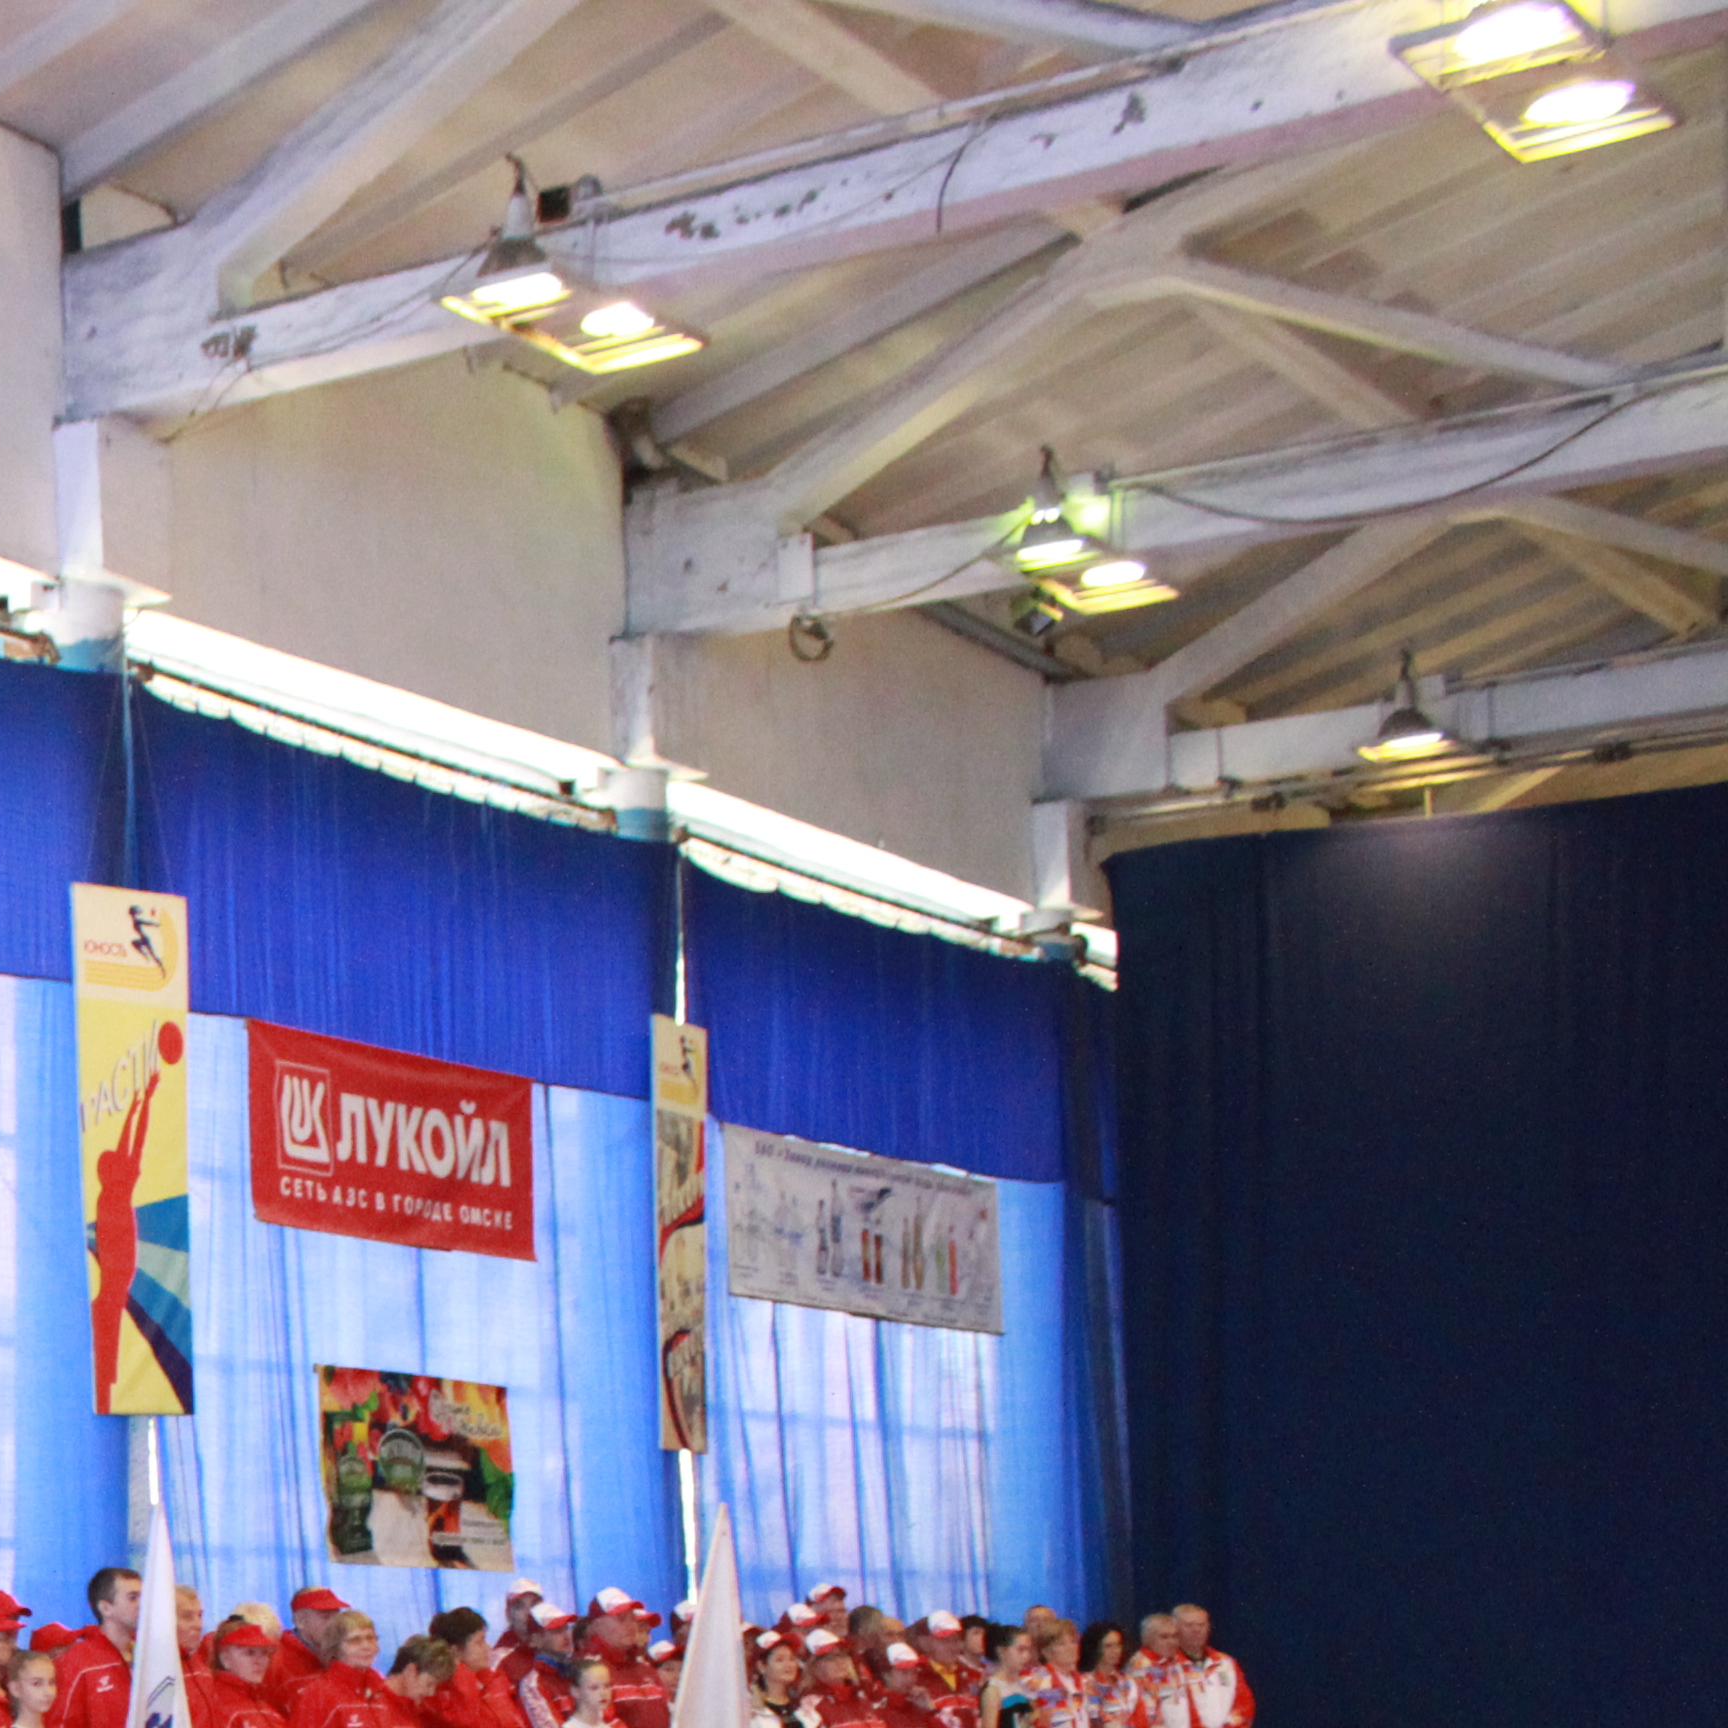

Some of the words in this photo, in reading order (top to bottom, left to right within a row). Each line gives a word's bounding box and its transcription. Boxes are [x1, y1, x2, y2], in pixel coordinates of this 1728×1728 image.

[84, 938, 127, 958] ЮНОСТЬ
[337, 1093, 511, 1187] ЛУКОЙЛ
[280, 1176, 327, 1202] СЕТЬ
[332, 1185, 368, 1208] АЗС
[375, 1192, 386, 1211] В
[392, 1194, 454, 1222] ГОРОДЕ
[459, 1205, 513, 1230] ОМСКЕ
